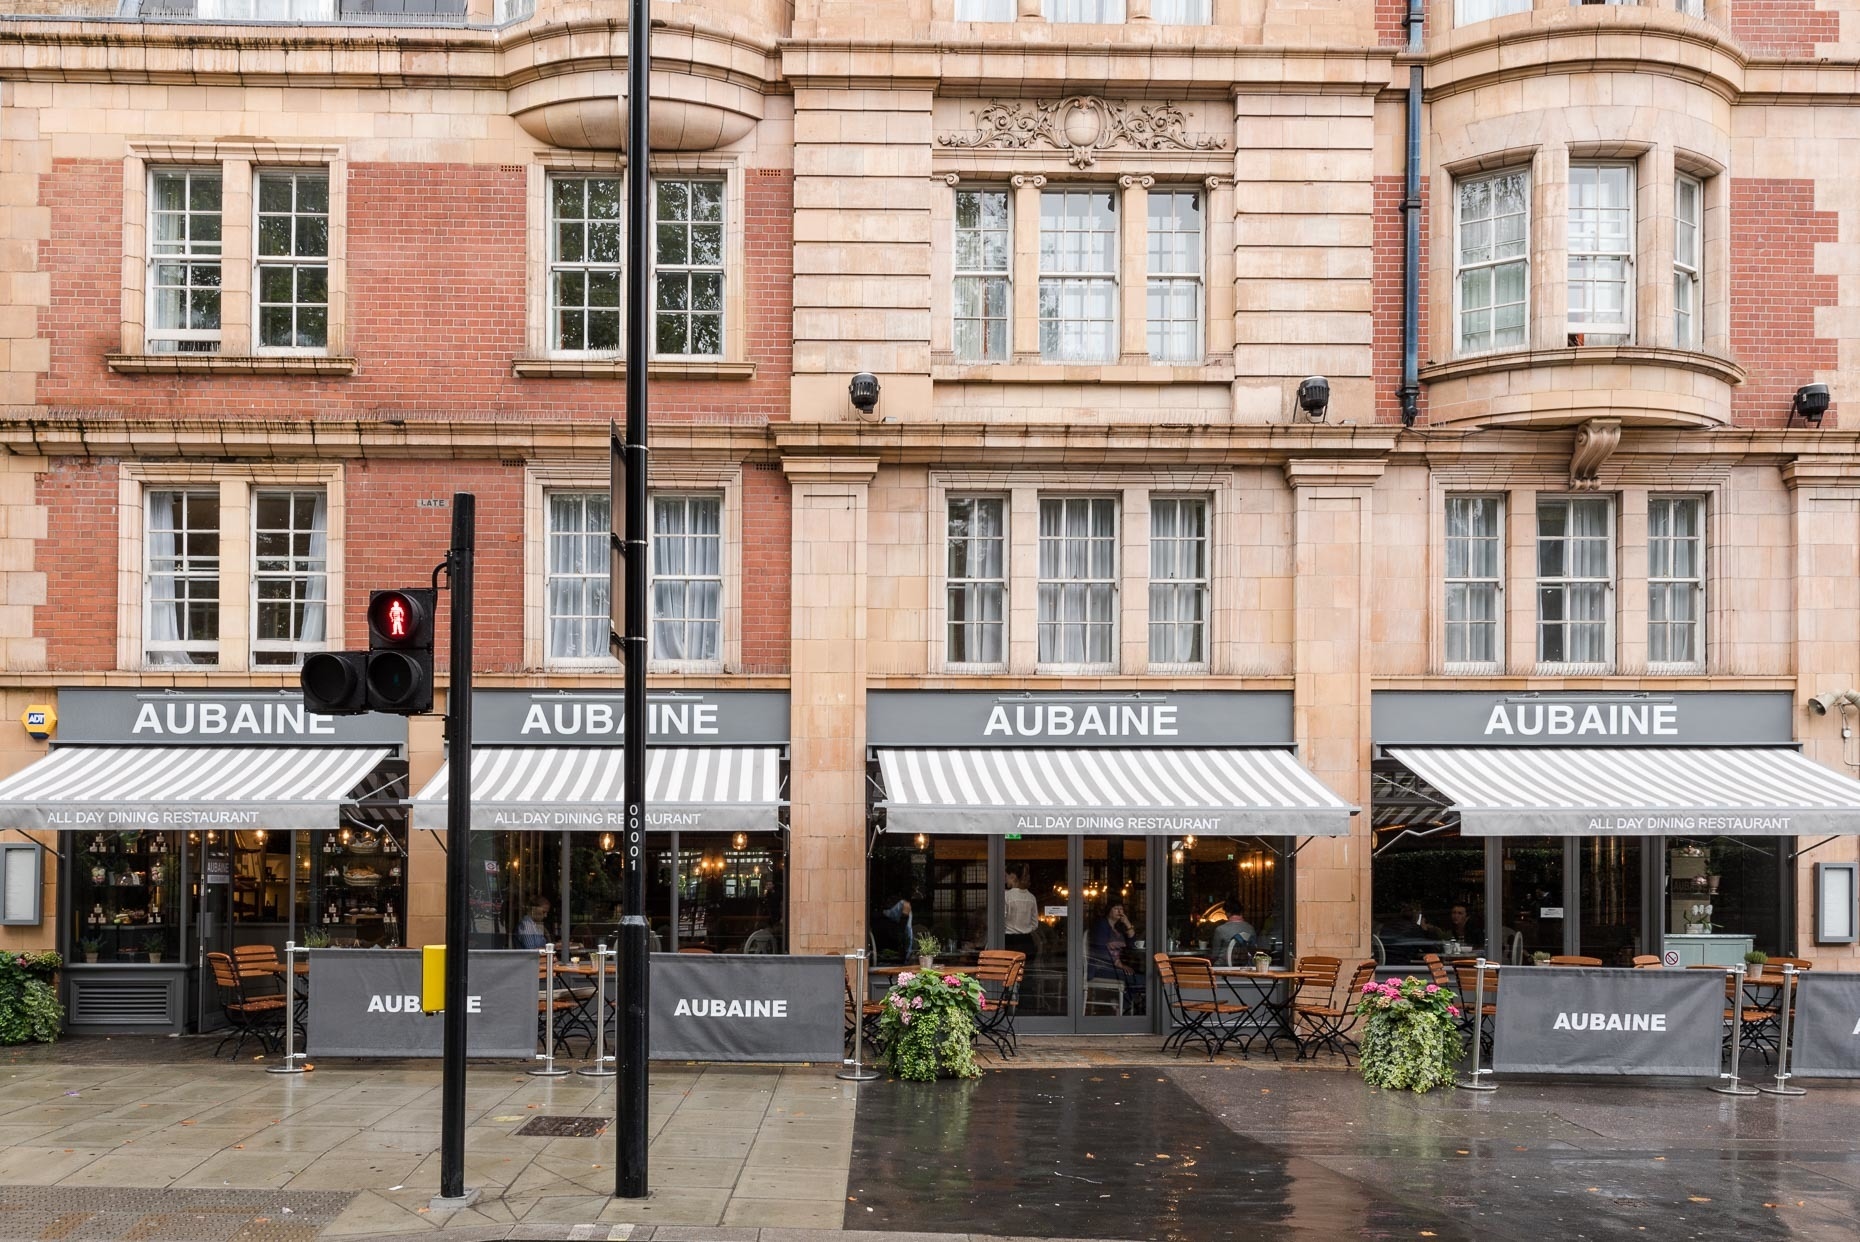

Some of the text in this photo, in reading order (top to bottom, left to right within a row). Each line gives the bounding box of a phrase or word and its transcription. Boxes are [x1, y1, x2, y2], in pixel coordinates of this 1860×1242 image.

[28, 713, 44, 724] ADT
[132, 703, 335, 734] AUBAINE
[520, 704, 719, 735] AUBINE
[983, 705, 1178, 736] AUBAINE
[1484, 705, 1678, 735] AUBAINE
[47, 811, 259, 824] ALL DAY DINING RESTAURANT
[494, 812, 701, 825] ALL DAY DINING REAURANT
[1017, 816, 1221, 830] ALL DAY DINING RESTAURANT
[1589, 817, 1791, 830] ALL DAY DINING RESTAURANT
[367, 995, 482, 1013] AUBE
[673, 998, 787, 1017] AUBAINE
[1552, 1012, 1667, 1031] AUBAINE
